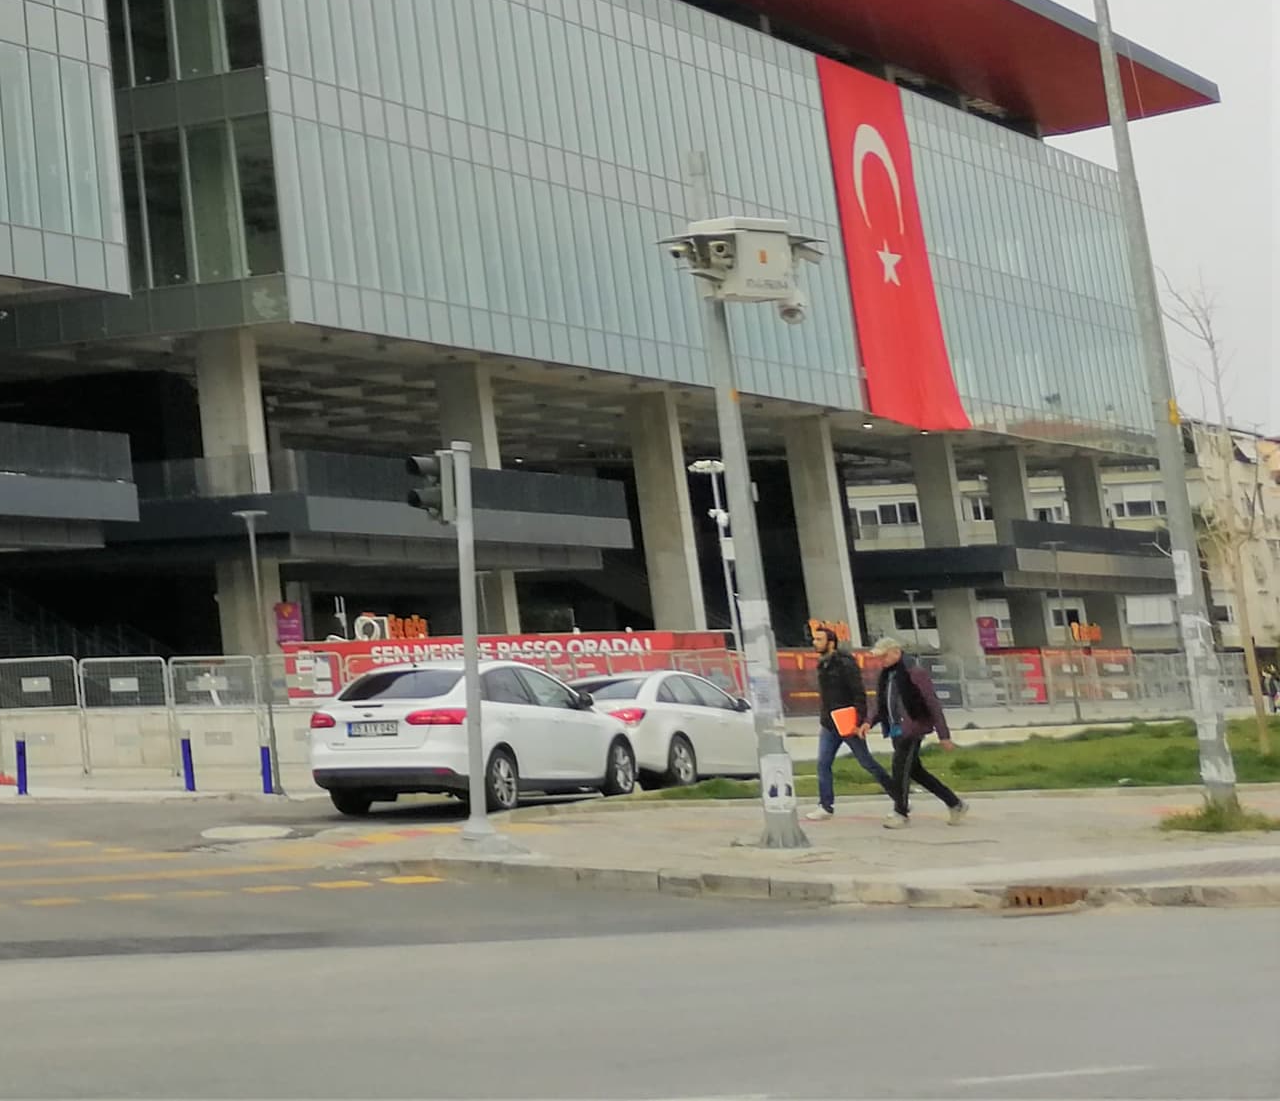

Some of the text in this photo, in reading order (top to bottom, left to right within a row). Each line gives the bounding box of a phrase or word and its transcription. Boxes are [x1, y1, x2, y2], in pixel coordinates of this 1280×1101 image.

[371, 637, 652, 664] SEN NEREE PASSO ORADA!
